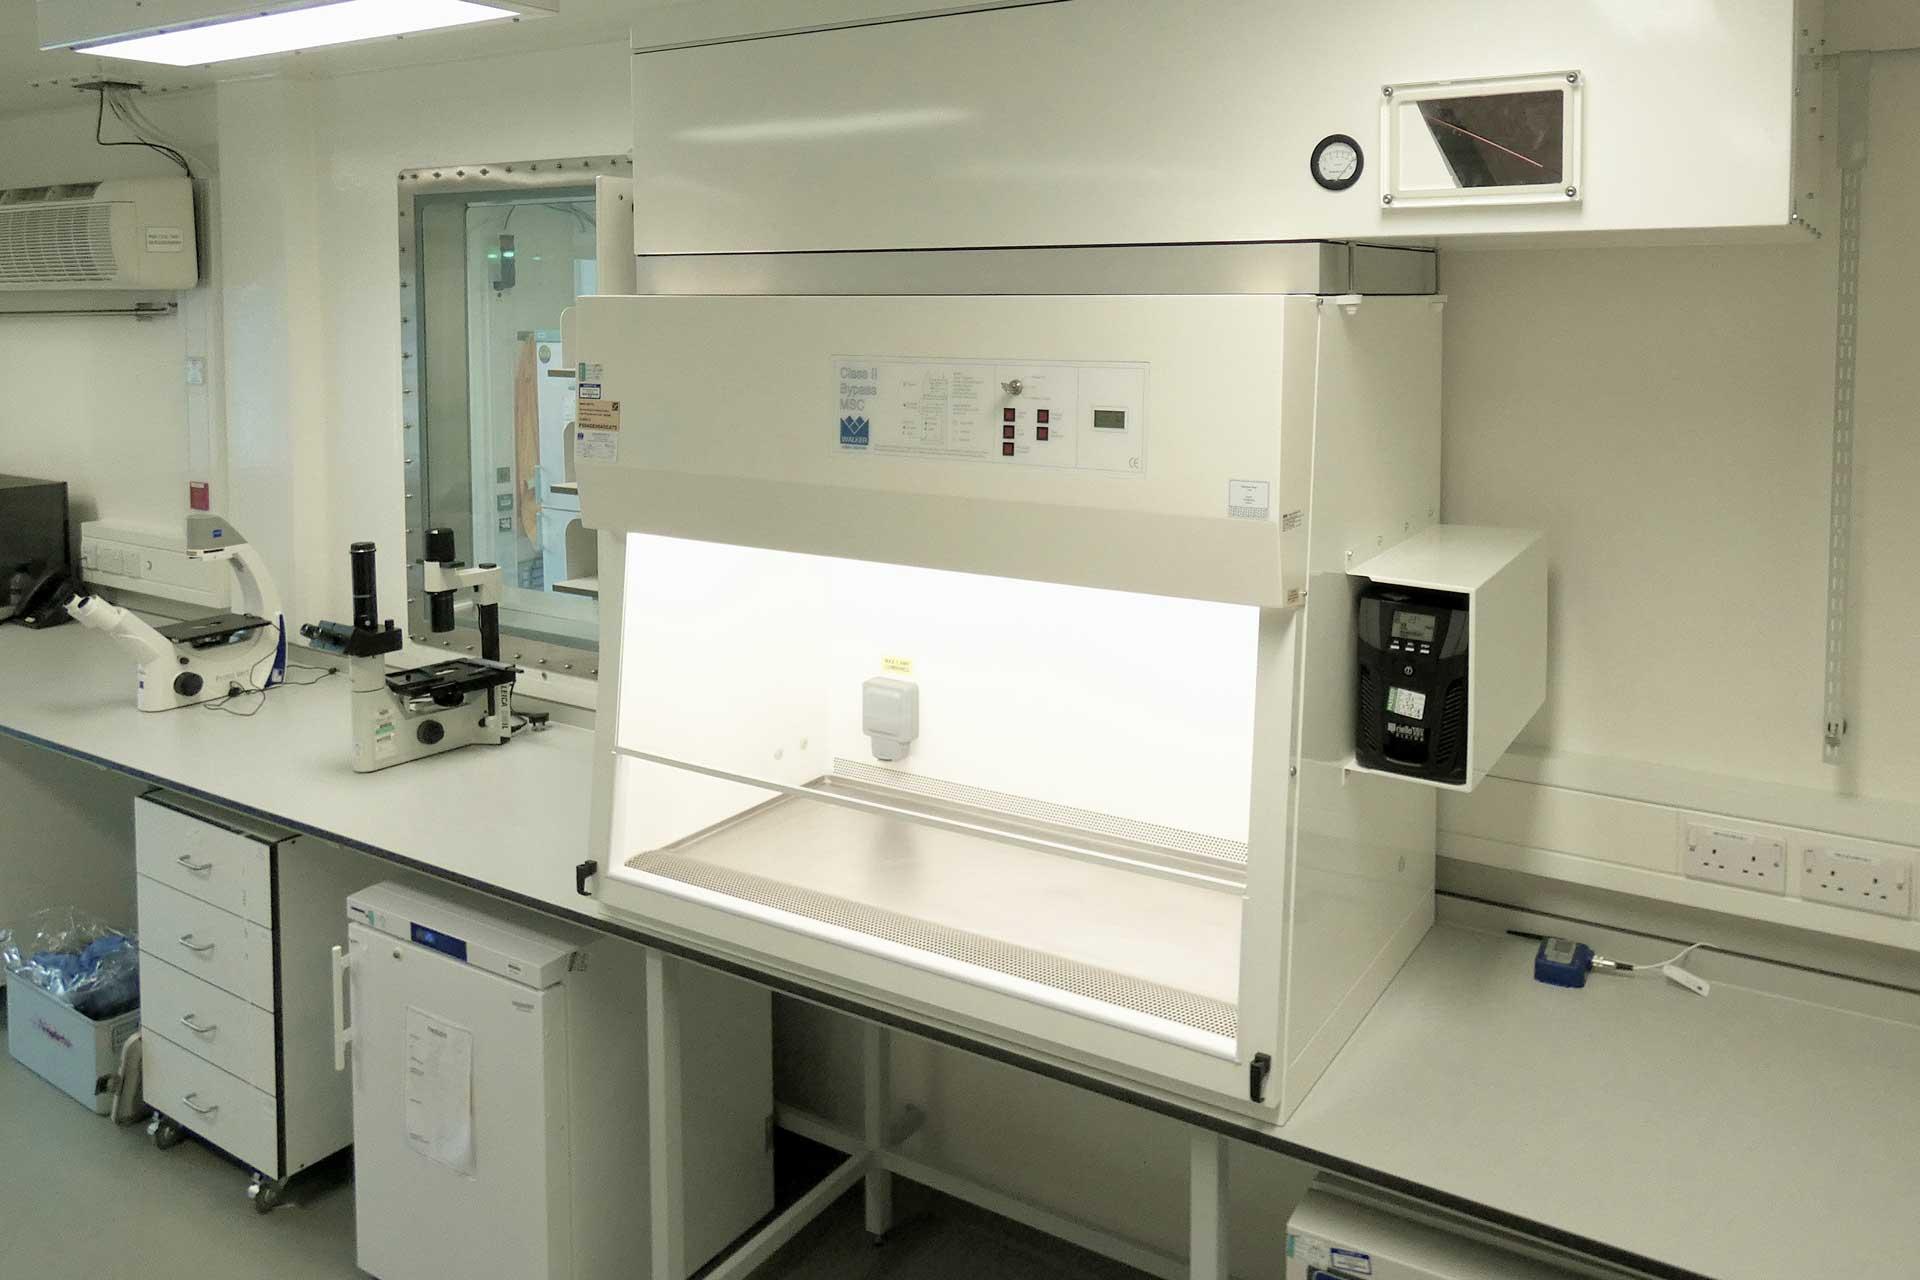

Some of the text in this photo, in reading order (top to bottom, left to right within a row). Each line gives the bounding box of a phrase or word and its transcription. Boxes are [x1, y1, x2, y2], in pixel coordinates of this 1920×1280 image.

[840, 367, 868, 380] Class
[840, 382, 877, 397] Bypass
[840, 398, 865, 411] MSC
[841, 436, 869, 444] WALKER
